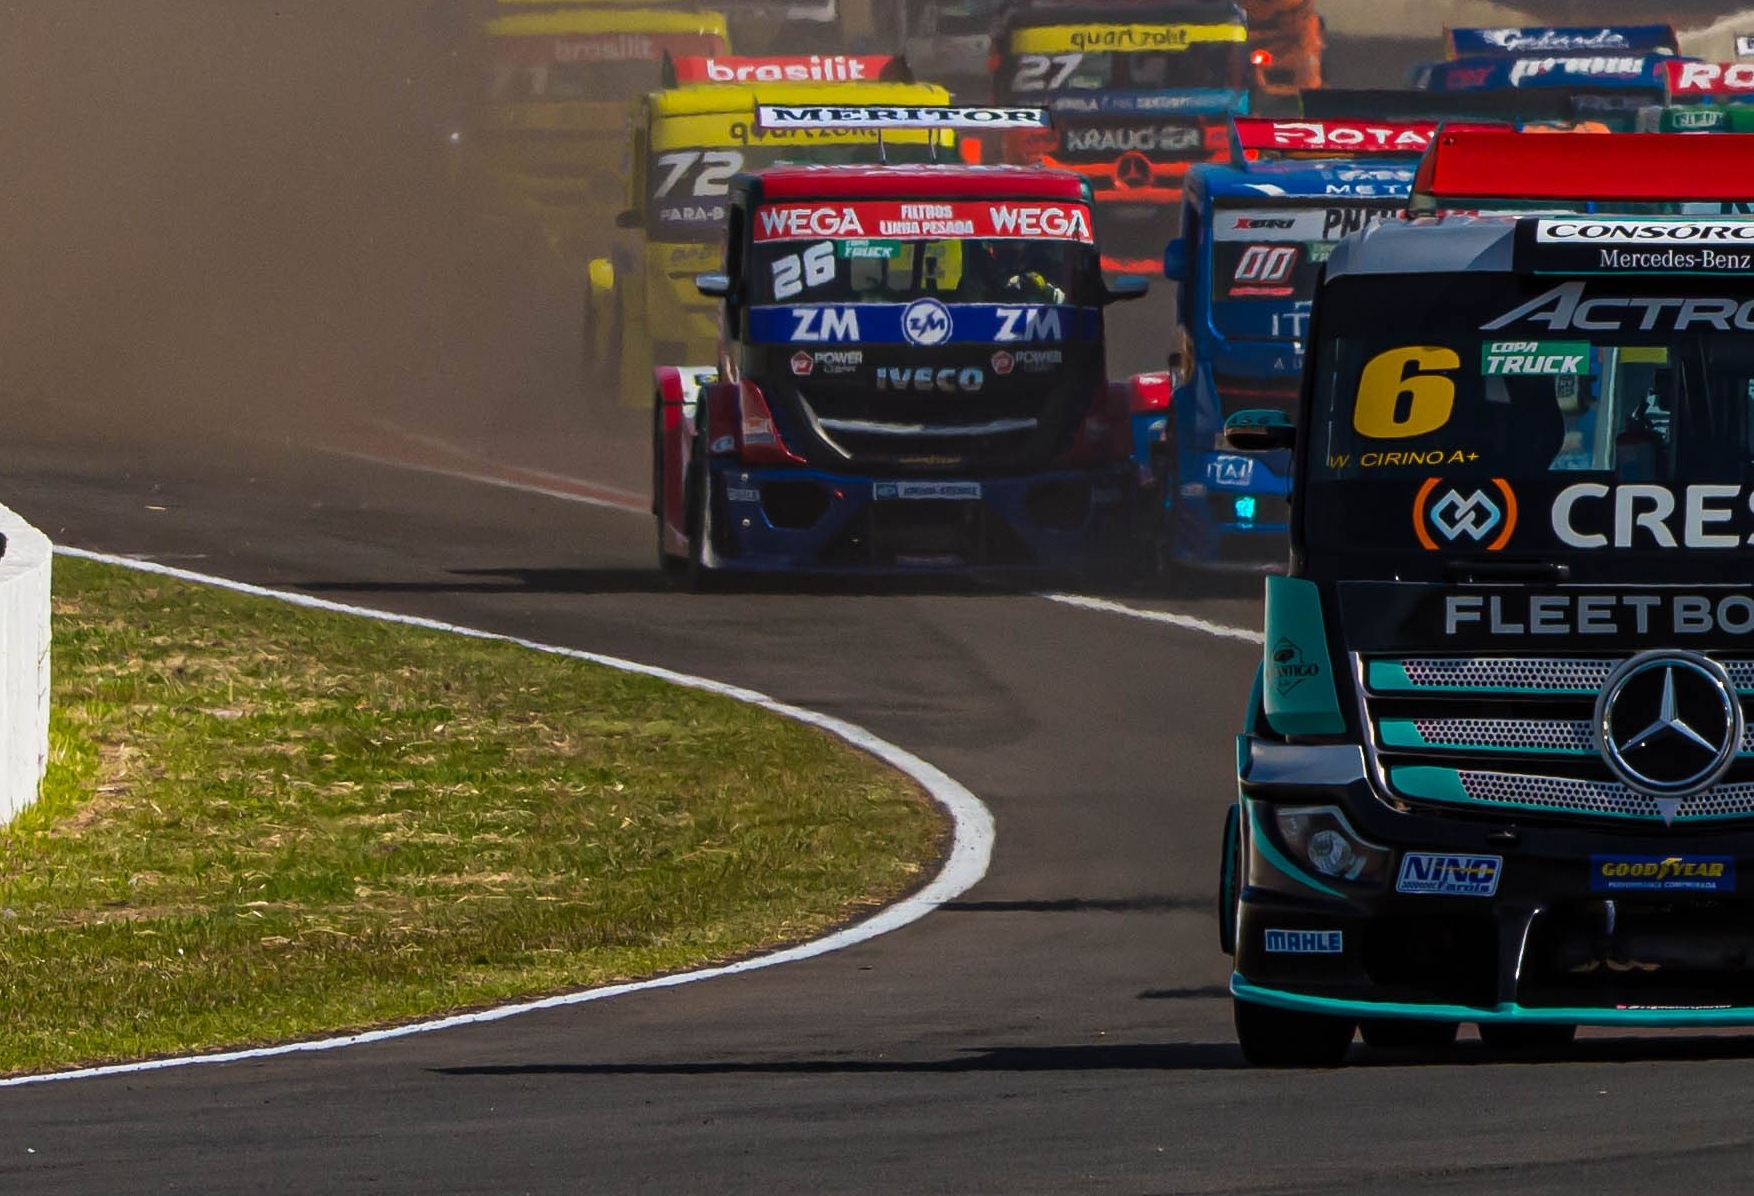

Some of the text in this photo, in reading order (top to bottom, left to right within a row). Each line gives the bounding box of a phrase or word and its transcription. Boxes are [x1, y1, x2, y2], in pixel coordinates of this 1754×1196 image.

[706, 56, 867, 82] brasilit
[1011, 53, 1084, 92] 27
[771, 107, 1041, 124] MERITOR
[653, 152, 744, 198] 72
[761, 206, 864, 236] WEGA
[989, 206, 1089, 237] WEGA
[771, 240, 836, 302] 26
[1599, 249, 1752, 270] Mercedes-Benz
[790, 308, 860, 342] ZM
[995, 307, 1062, 342] ZM
[1491, 341, 1538, 354] COPA
[1487, 355, 1584, 374] TRUCK
[876, 366, 984, 392] IVECO
[1353, 345, 1461, 439] 6
[1360, 450, 1443, 467] CIRINO
[1447, 449, 1480, 466] A+
[1403, 856, 1497, 883] NINO
[1602, 858, 1724, 880] GOODYEAR
[1267, 931, 1341, 951] MAHLE
